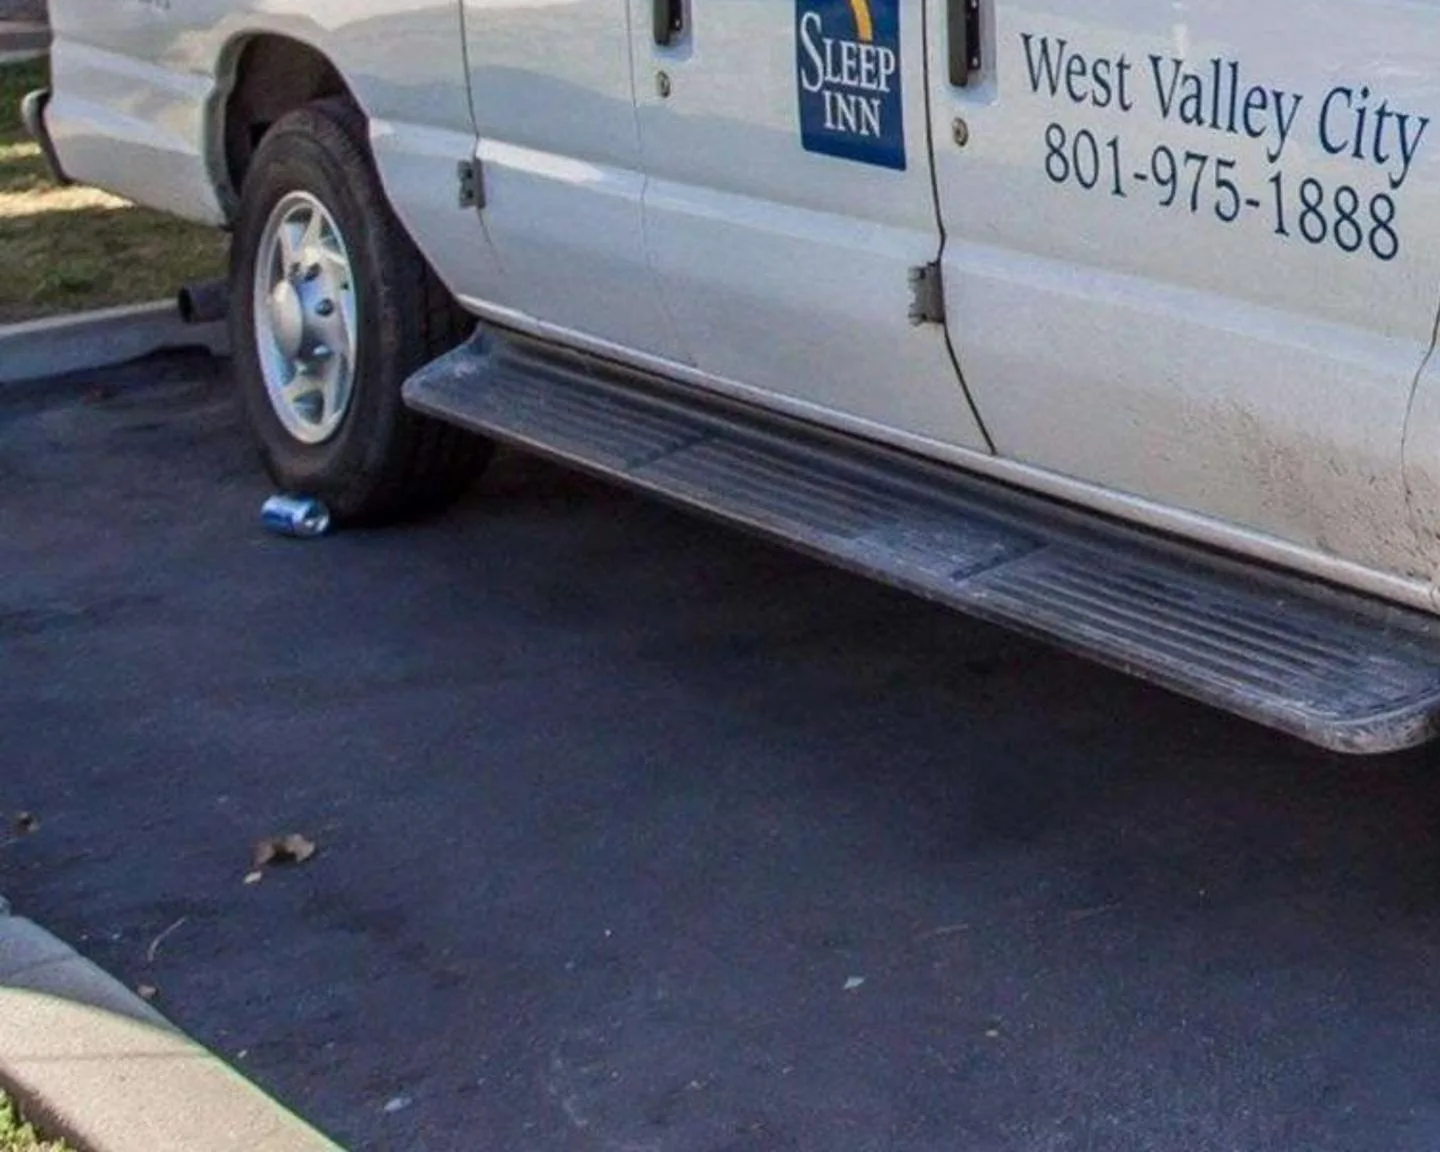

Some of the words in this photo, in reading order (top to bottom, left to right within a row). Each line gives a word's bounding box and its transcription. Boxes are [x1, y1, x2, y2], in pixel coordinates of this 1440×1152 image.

[801, 11, 895, 93] SLEEP
[822, 90, 881, 139] INN
[1021, 32, 1133, 114] West
[1148, 54, 1304, 164] Valley
[1318, 85, 1430, 190] City
[1044, 122, 1400, 262] 801-975-1888
